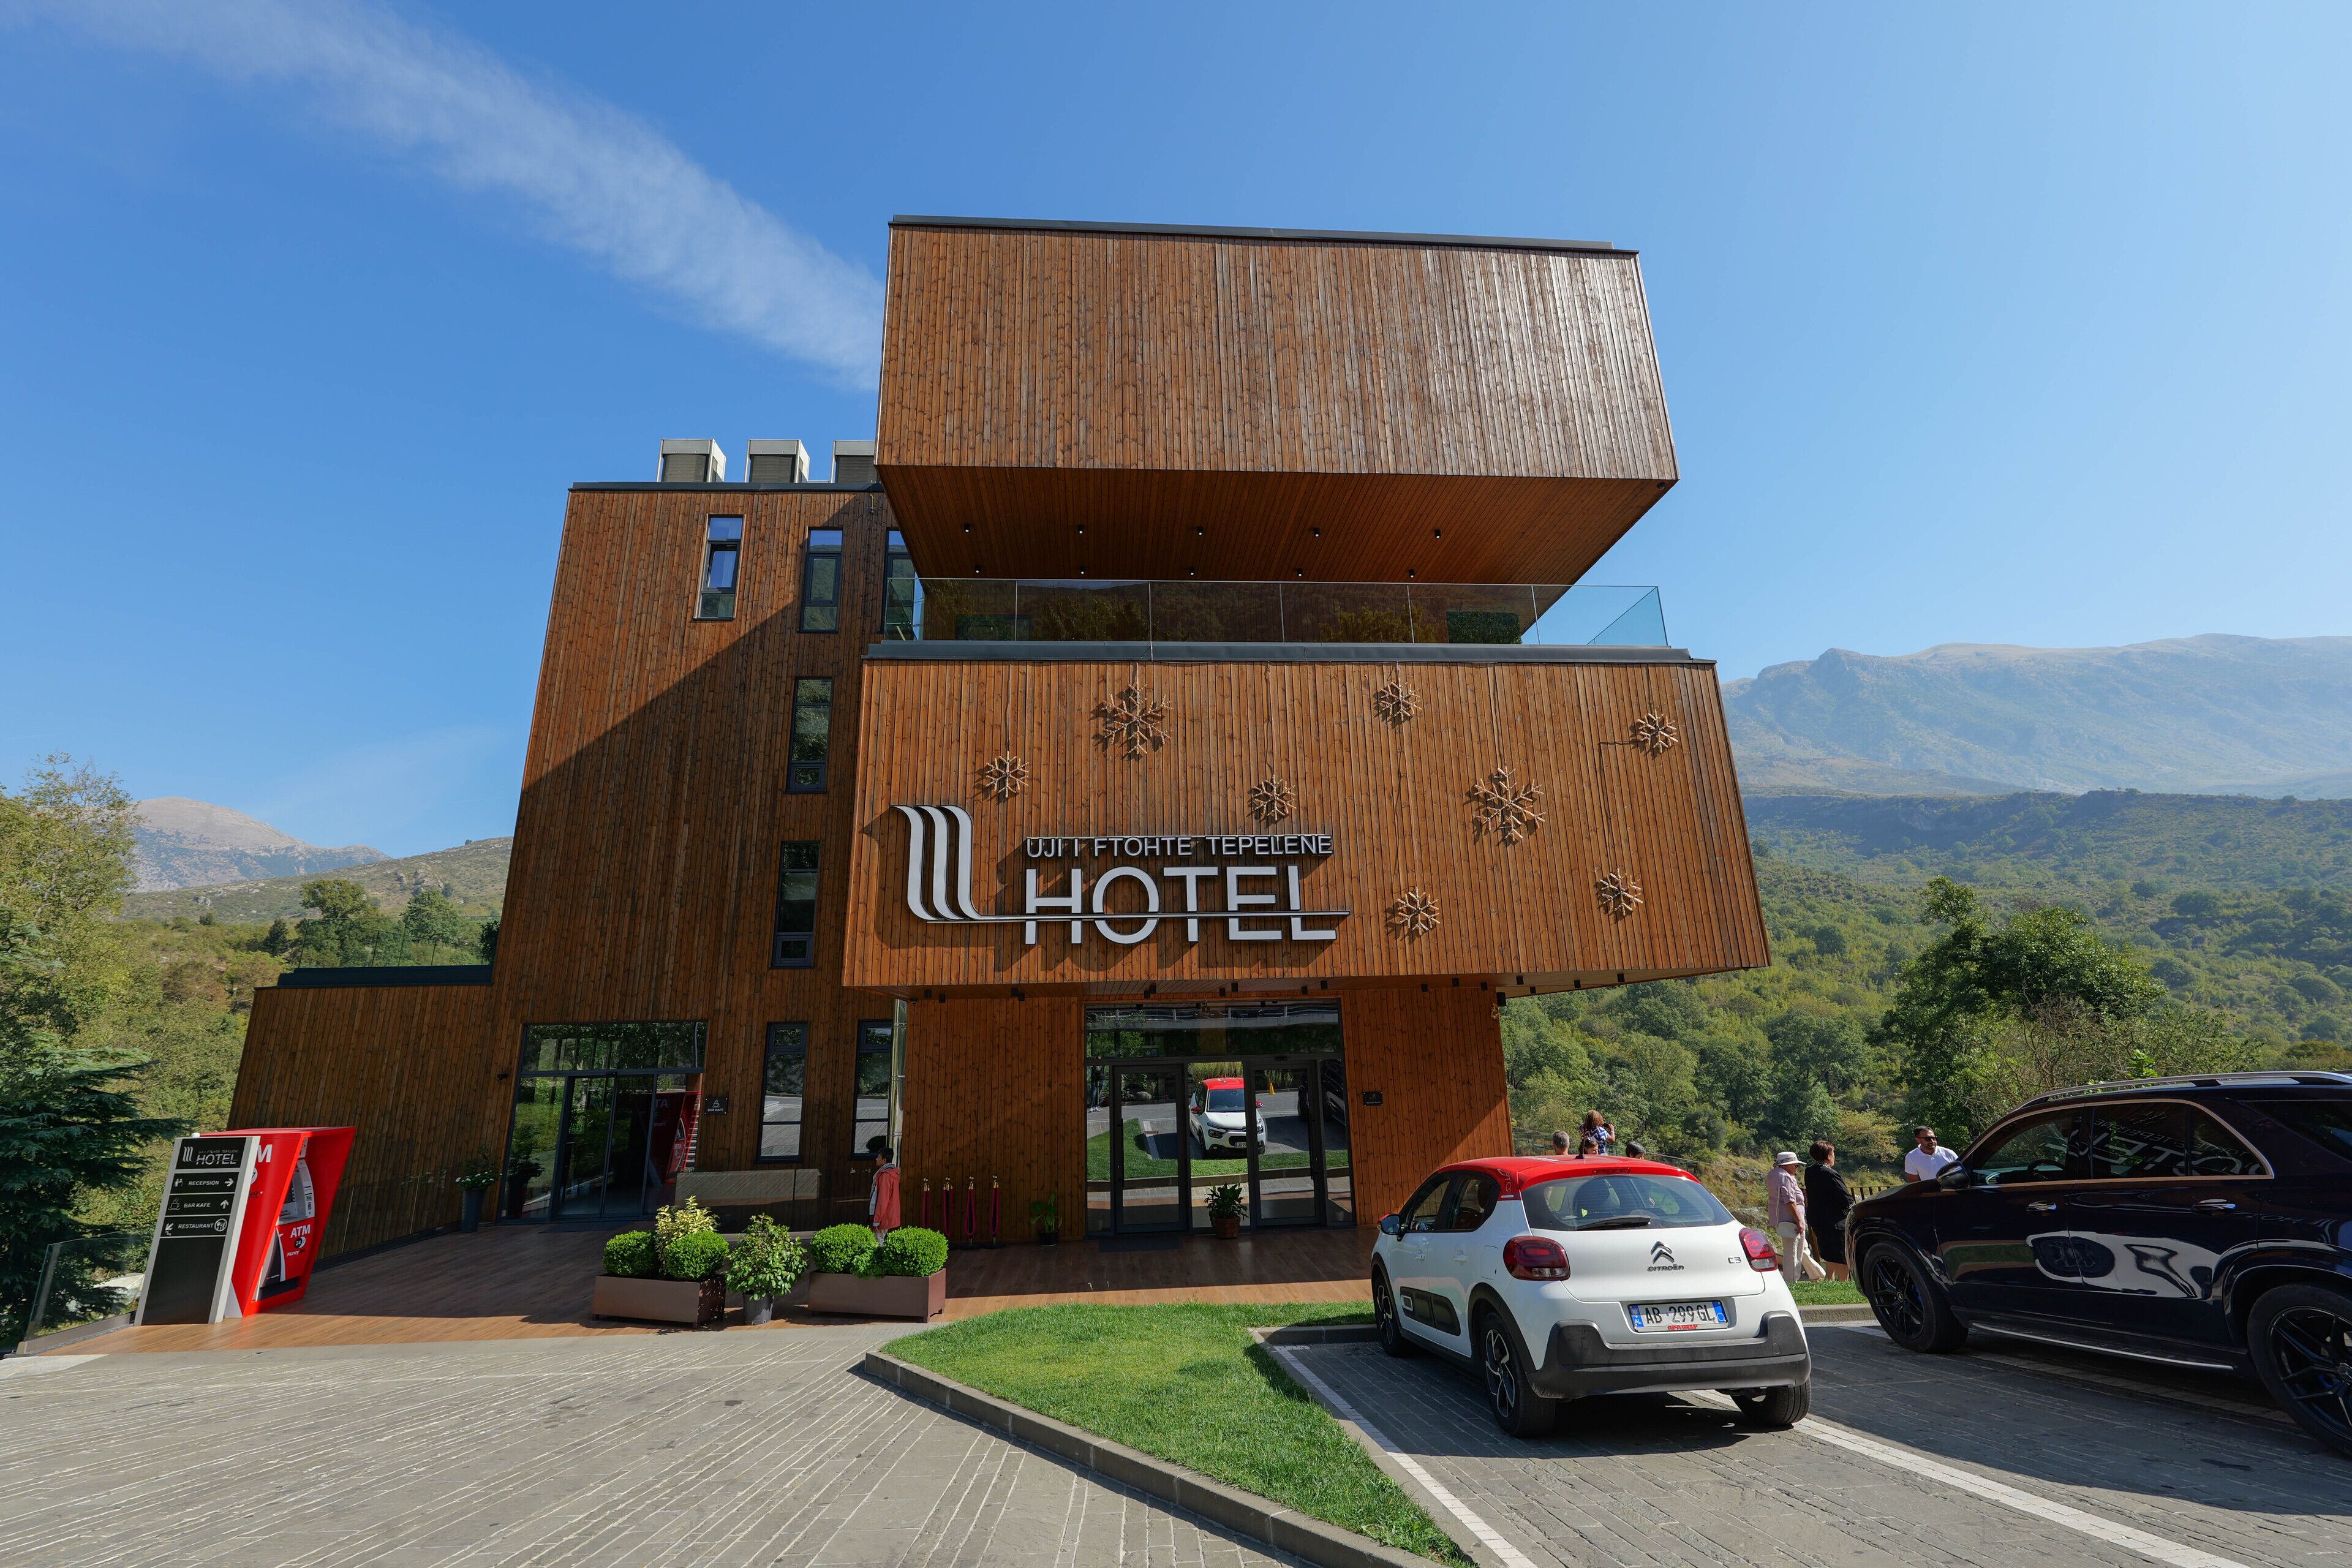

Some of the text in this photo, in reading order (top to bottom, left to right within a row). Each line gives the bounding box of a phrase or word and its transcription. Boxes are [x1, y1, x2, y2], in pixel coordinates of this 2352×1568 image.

[1027, 838, 1063, 858] UJI
[1074, 837, 1079, 857] I
[1025, 865, 1337, 945] HOTEL
[195, 1153, 237, 1166] HOTEL
[290, 1224, 311, 1238] ATM
[1647, 1263, 1684, 1272] CITROËN
[1645, 1306, 1663, 1324] AB
